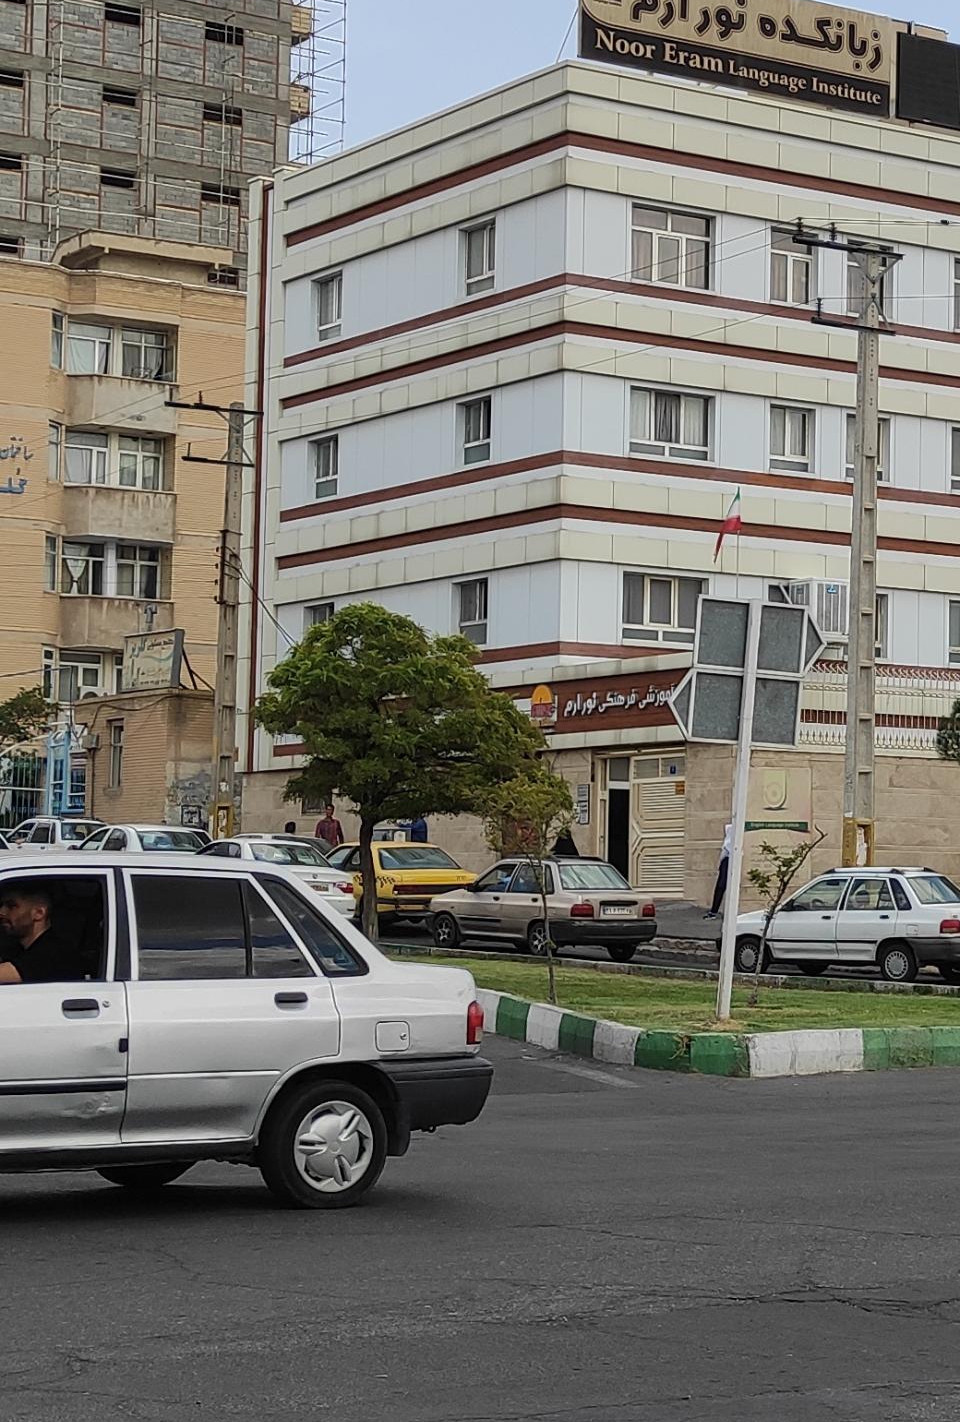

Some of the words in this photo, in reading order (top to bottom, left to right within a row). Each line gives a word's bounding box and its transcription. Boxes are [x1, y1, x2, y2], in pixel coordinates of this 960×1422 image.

[757, 14, 883, 72] زبانکده
[594, 27, 656, 59] Noor
[663, 41, 724, 73] Eram
[728, 59, 807, 93] Language
[812, 76, 882, 105] Institute
[563, 693, 581, 717] ارم
[581, 692, 597, 715] نور
[597, 688, 639, 713] فرهنگی
